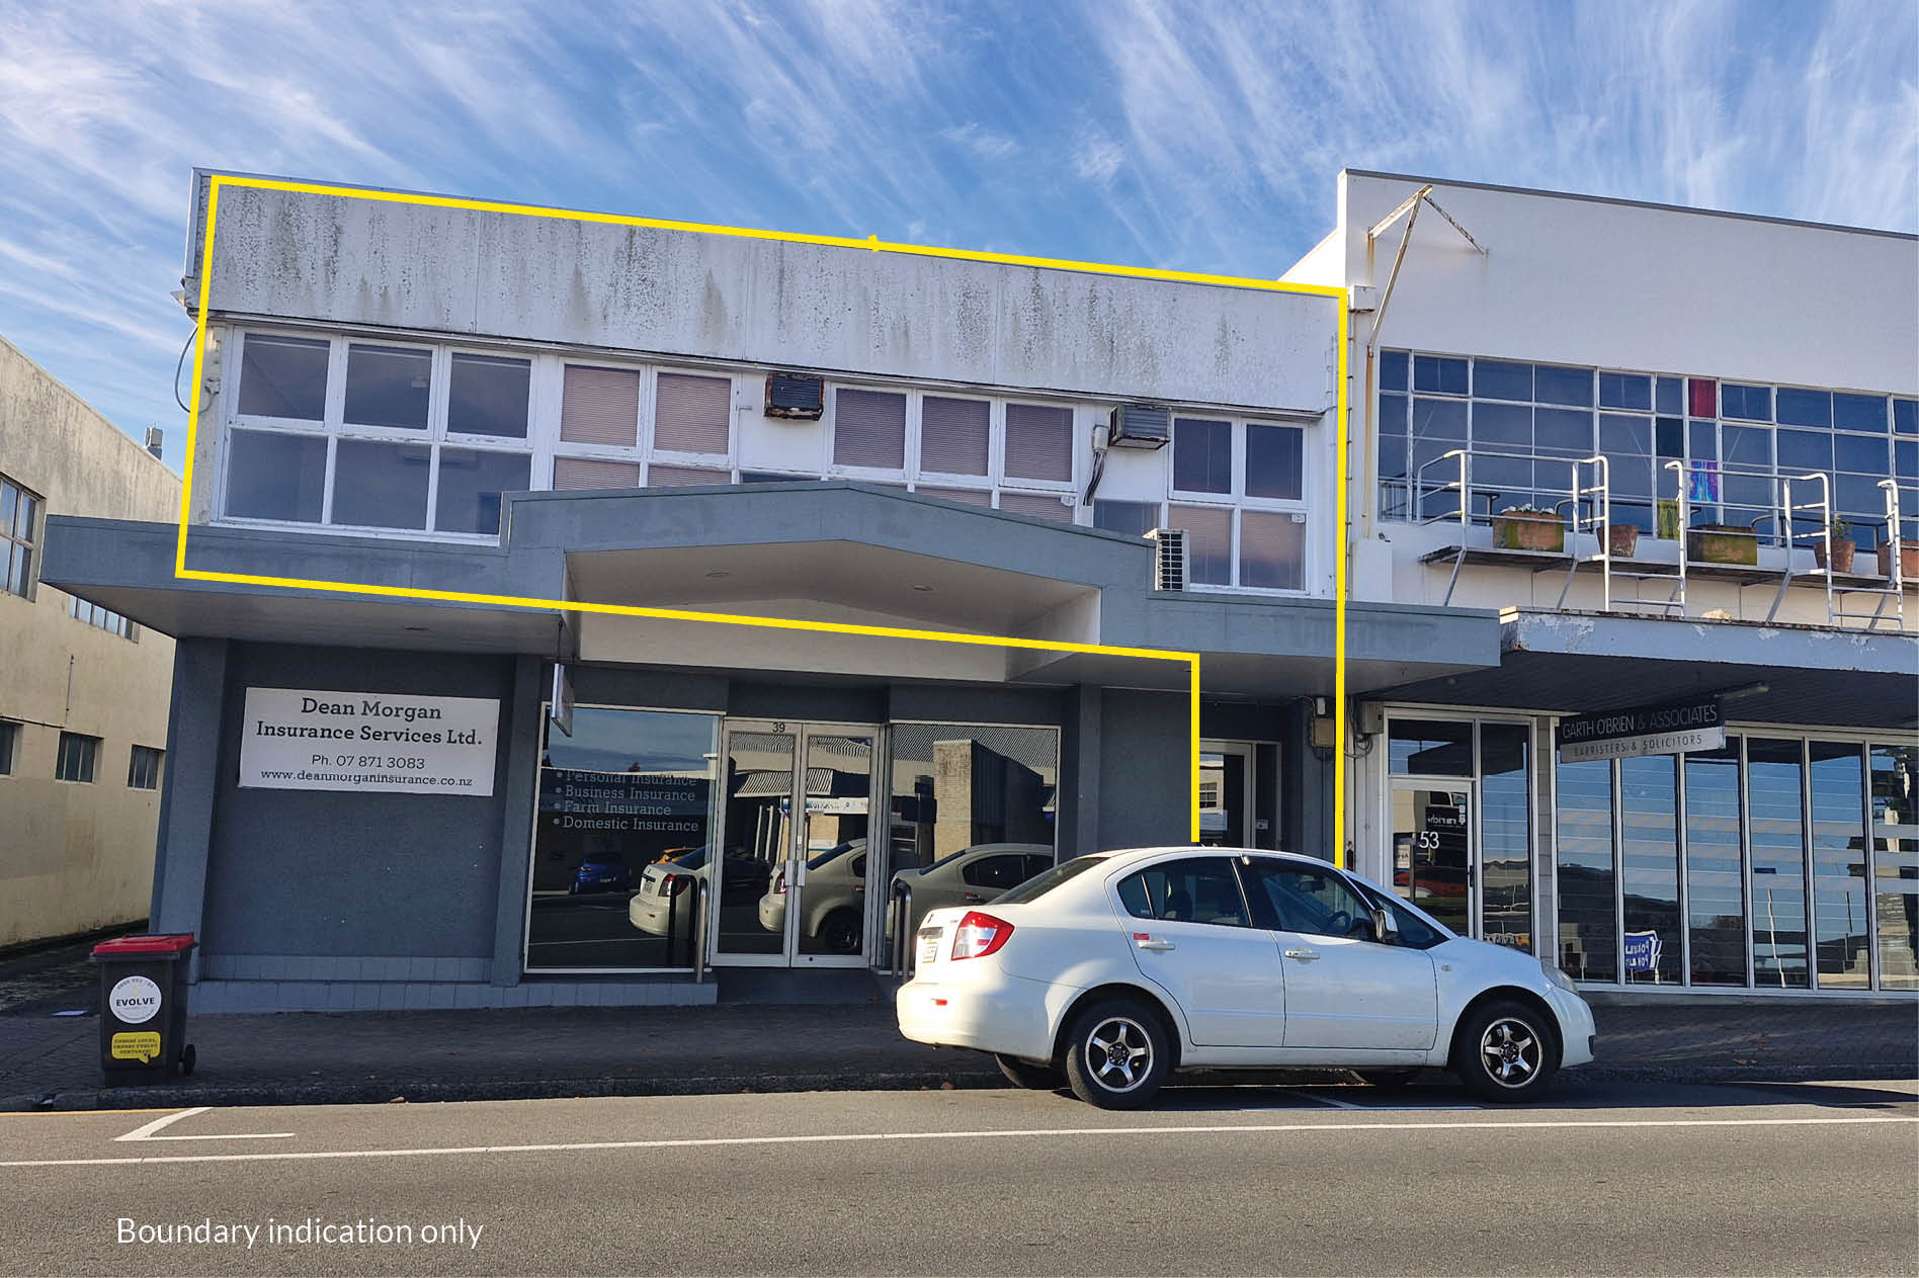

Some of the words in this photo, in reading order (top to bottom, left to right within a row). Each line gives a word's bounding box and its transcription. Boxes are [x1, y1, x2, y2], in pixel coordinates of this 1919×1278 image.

[301, 697, 355, 716] Dean
[361, 700, 442, 722] Morgan
[772, 722, 786, 733] 39
[1563, 720, 1594, 739] GARTH
[1597, 714, 1635, 735] O'BRIEN
[1637, 715, 1646, 730] &
[1649, 704, 1718, 729] ASSOCIATES
[256, 721, 355, 740] Insurance
[360, 726, 442, 744] Services
[446, 729, 483, 745] Ltd.
[1643, 735, 1703, 751] SOLICITORS
[312, 754, 332, 767] Ph.
[336, 755, 354, 767] 07
[359, 756, 383, 769] 871
[387, 757, 425, 770] 3083
[261, 770, 473, 787] www.deanmorganinsurance.co.nz
[567, 770, 627, 784] Personal
[565, 785, 625, 800] Business
[630, 787, 696, 801] Insurance
[564, 800, 600, 815] Farm
[605, 801, 672, 816] Insurance
[563, 815, 629, 830] Domestic
[633, 817, 699, 832] Insurance
[1419, 831, 1440, 849] 53
[116, 997, 155, 1007] EVOLVE
